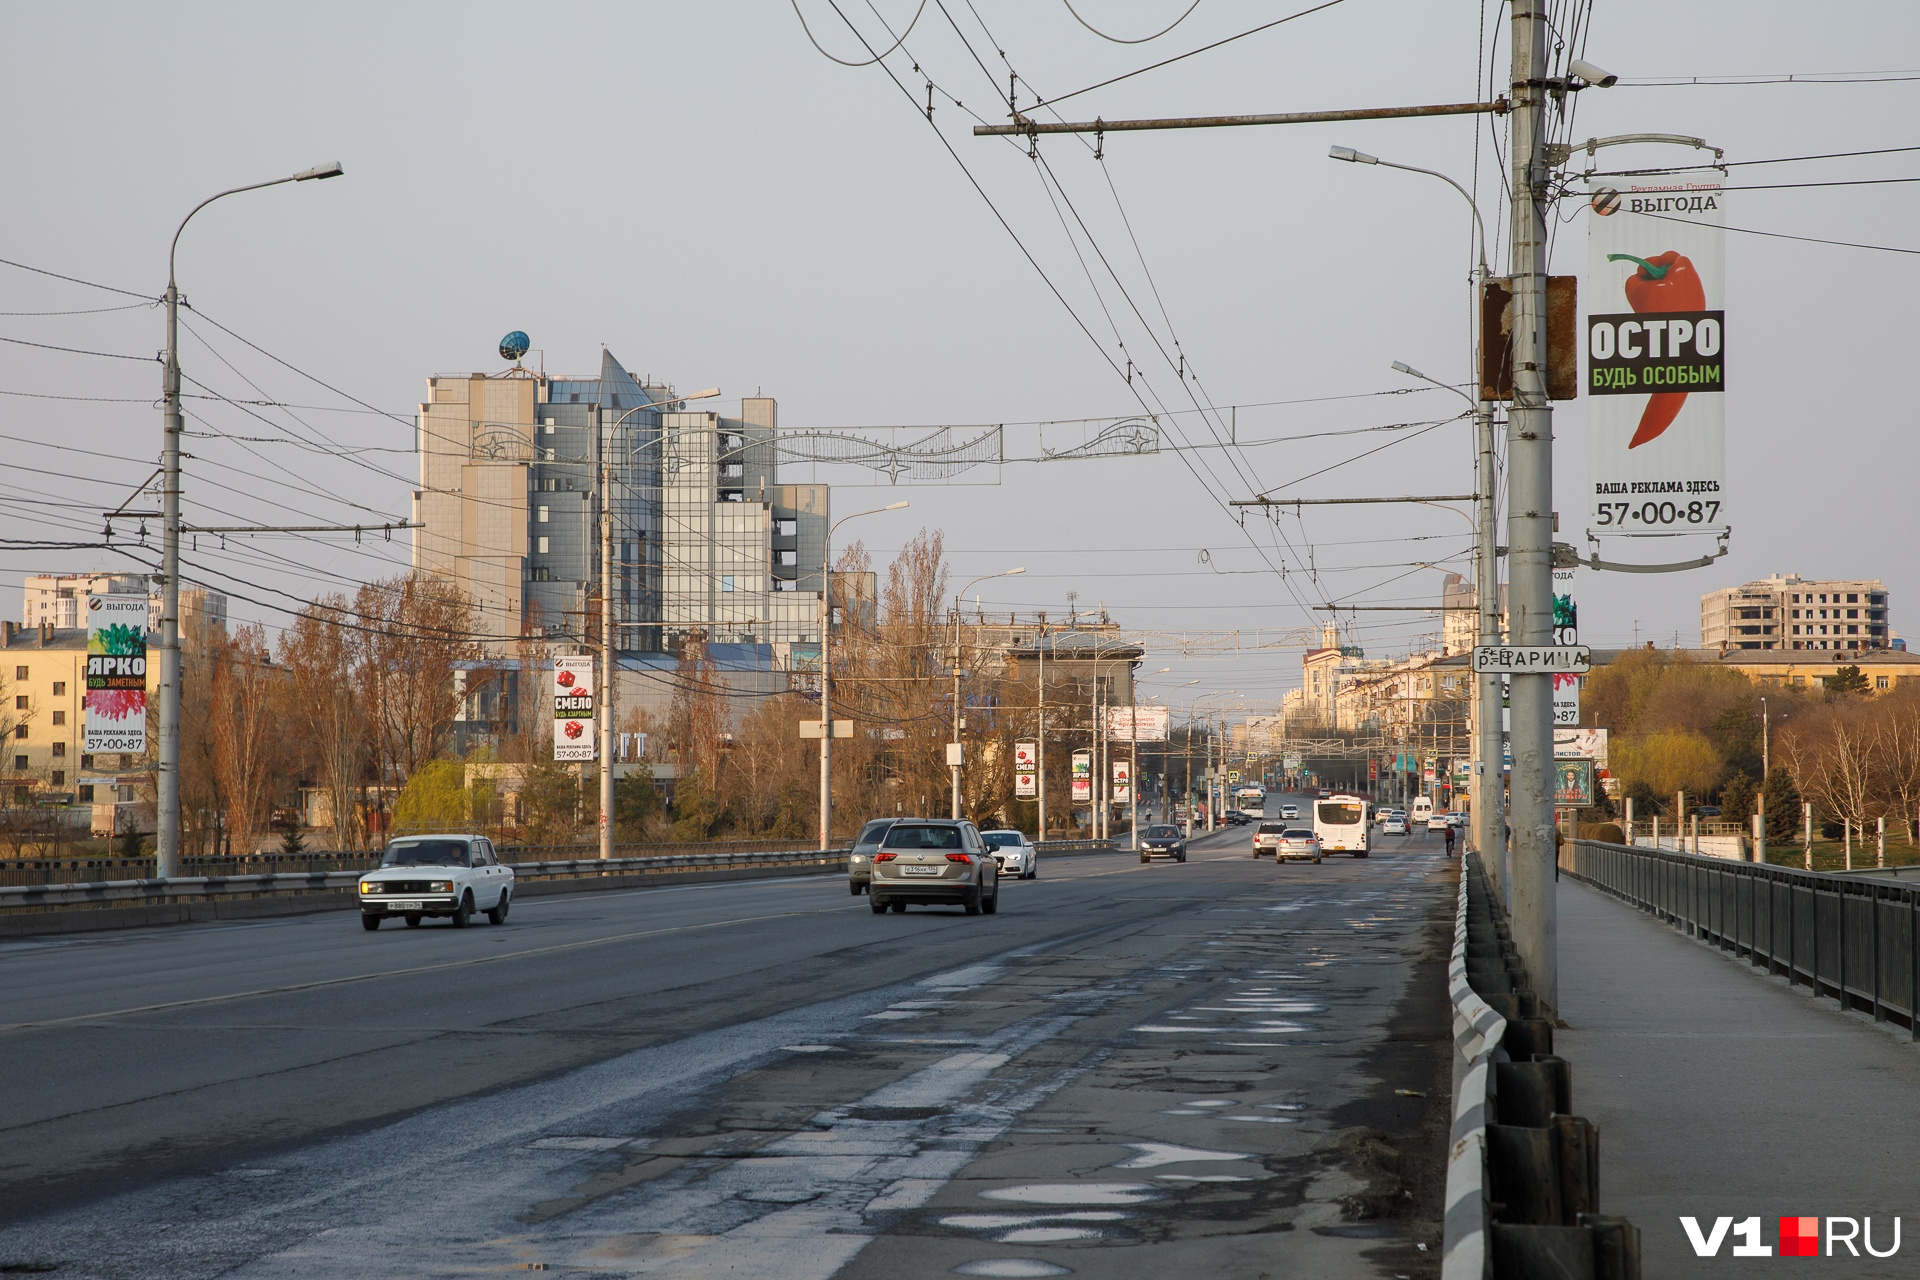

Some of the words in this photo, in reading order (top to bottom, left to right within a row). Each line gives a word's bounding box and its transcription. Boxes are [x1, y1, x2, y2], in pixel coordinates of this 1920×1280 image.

[1631, 196, 1718, 213] ВЫГОДА
[1591, 318, 1720, 360] ОСТРО
[1593, 367, 1637, 389] БУДЬ
[1643, 364, 1720, 385] ОСОБЫМ
[1596, 482, 1628, 494] ВАША
[1631, 481, 1684, 494] РЕКЛАМА
[1686, 480, 1720, 495] ЗДЕСЬ
[106, 603, 144, 611] ВЫГОДА
[88, 657, 146, 675] ЯРКО
[88, 678, 106, 688] БУДЬ
[107, 677, 145, 687] ЗАМЕТНЫМ
[555, 697, 592, 710] СМЕЛО
